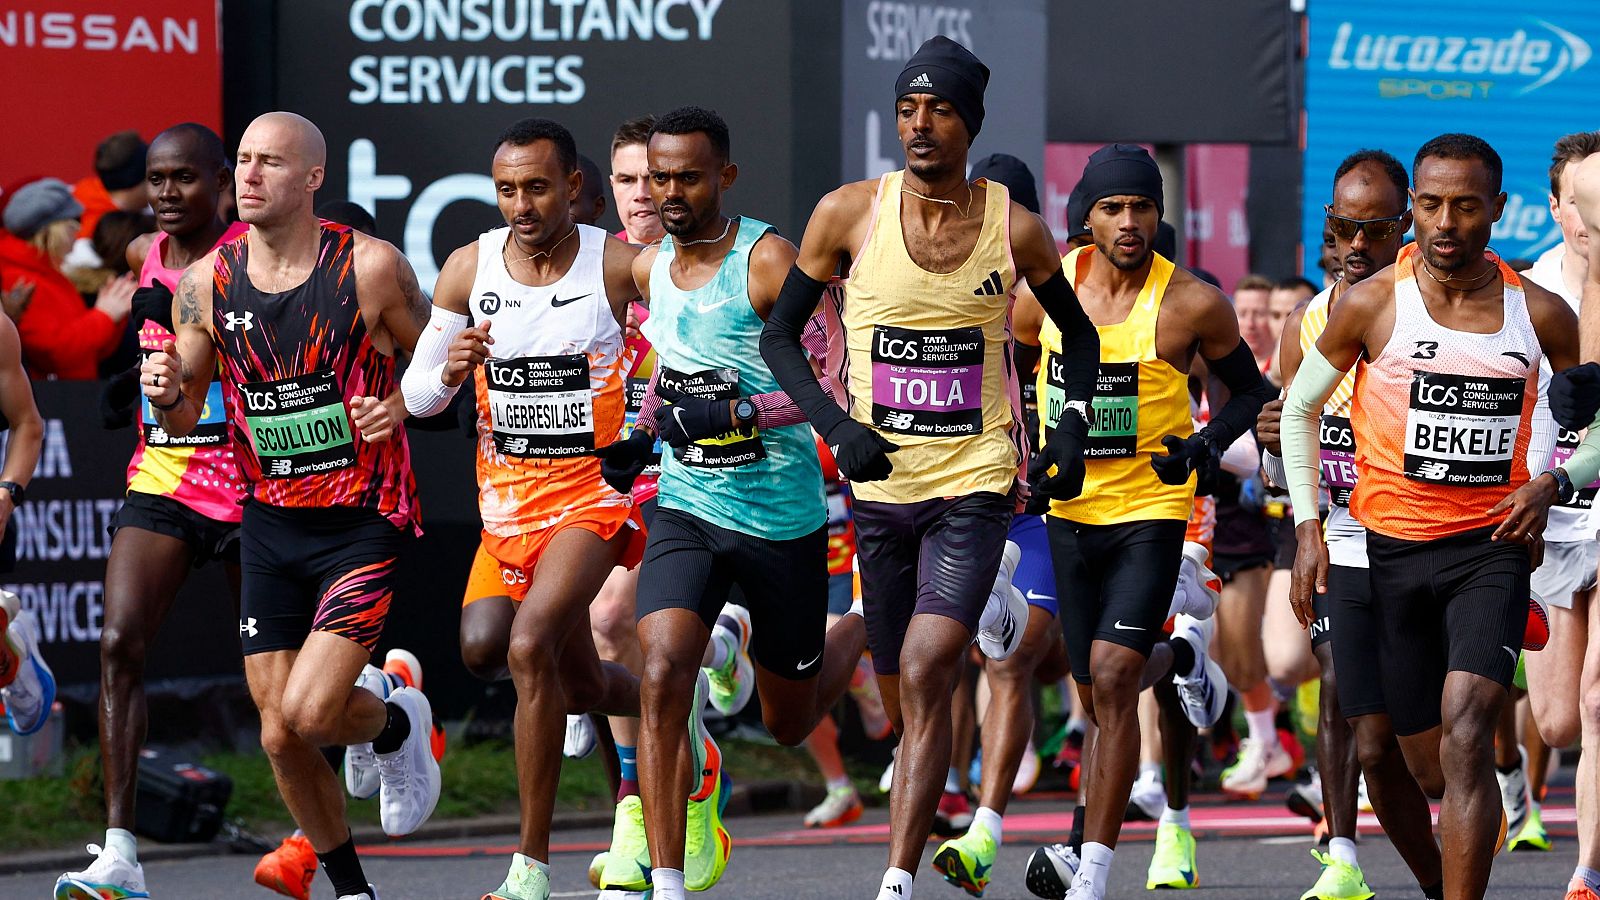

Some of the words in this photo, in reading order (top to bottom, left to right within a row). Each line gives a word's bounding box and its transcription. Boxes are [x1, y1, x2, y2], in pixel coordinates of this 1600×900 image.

[349, 0, 724, 42] CONSULTANCY
[1328, 22, 1553, 75] Lucozade
[349, 55, 586, 104] SERVICES
[1378, 78, 1496, 100] SPORT
[504, 300, 521, 308] NN
[922, 336, 947, 344] TATA
[878, 332, 918, 361] tcs
[922, 343, 978, 353] CONSULTANCY
[922, 353, 959, 361] SERVICES
[528, 362, 552, 370] TATA
[490, 361, 525, 387] tcs
[528, 368, 583, 378] CONSULTANCY
[276, 382, 300, 393] TATA
[529, 378, 564, 387] SERVICES
[684, 382, 732, 393] CONSULTANCY
[1463, 382, 1489, 391] TATA
[278, 383, 332, 401] CONSULTANCY
[889, 376, 965, 407] TOLA
[1417, 377, 1459, 407] tcs
[1462, 391, 1518, 401] CONSULTANCY
[247, 389, 277, 410] tcs
[280, 395, 315, 409] SERVICES
[1462, 400, 1499, 410] SERVICES
[506, 402, 587, 429] GEBRESILASE
[255, 415, 345, 452] SCULLION
[914, 424, 934, 432] new
[935, 423, 973, 433] balance
[1319, 420, 1352, 447] tcs
[187, 435, 220, 444] balance
[1414, 423, 1512, 456] BEKELE
[548, 446, 586, 455] balance
[1091, 447, 1127, 456] balance
[704, 457, 720, 465] new
[720, 452, 756, 464] balance
[294, 465, 312, 474] new
[311, 458, 349, 471] balance
[1448, 474, 1468, 482] new
[1469, 474, 1503, 483] balance
